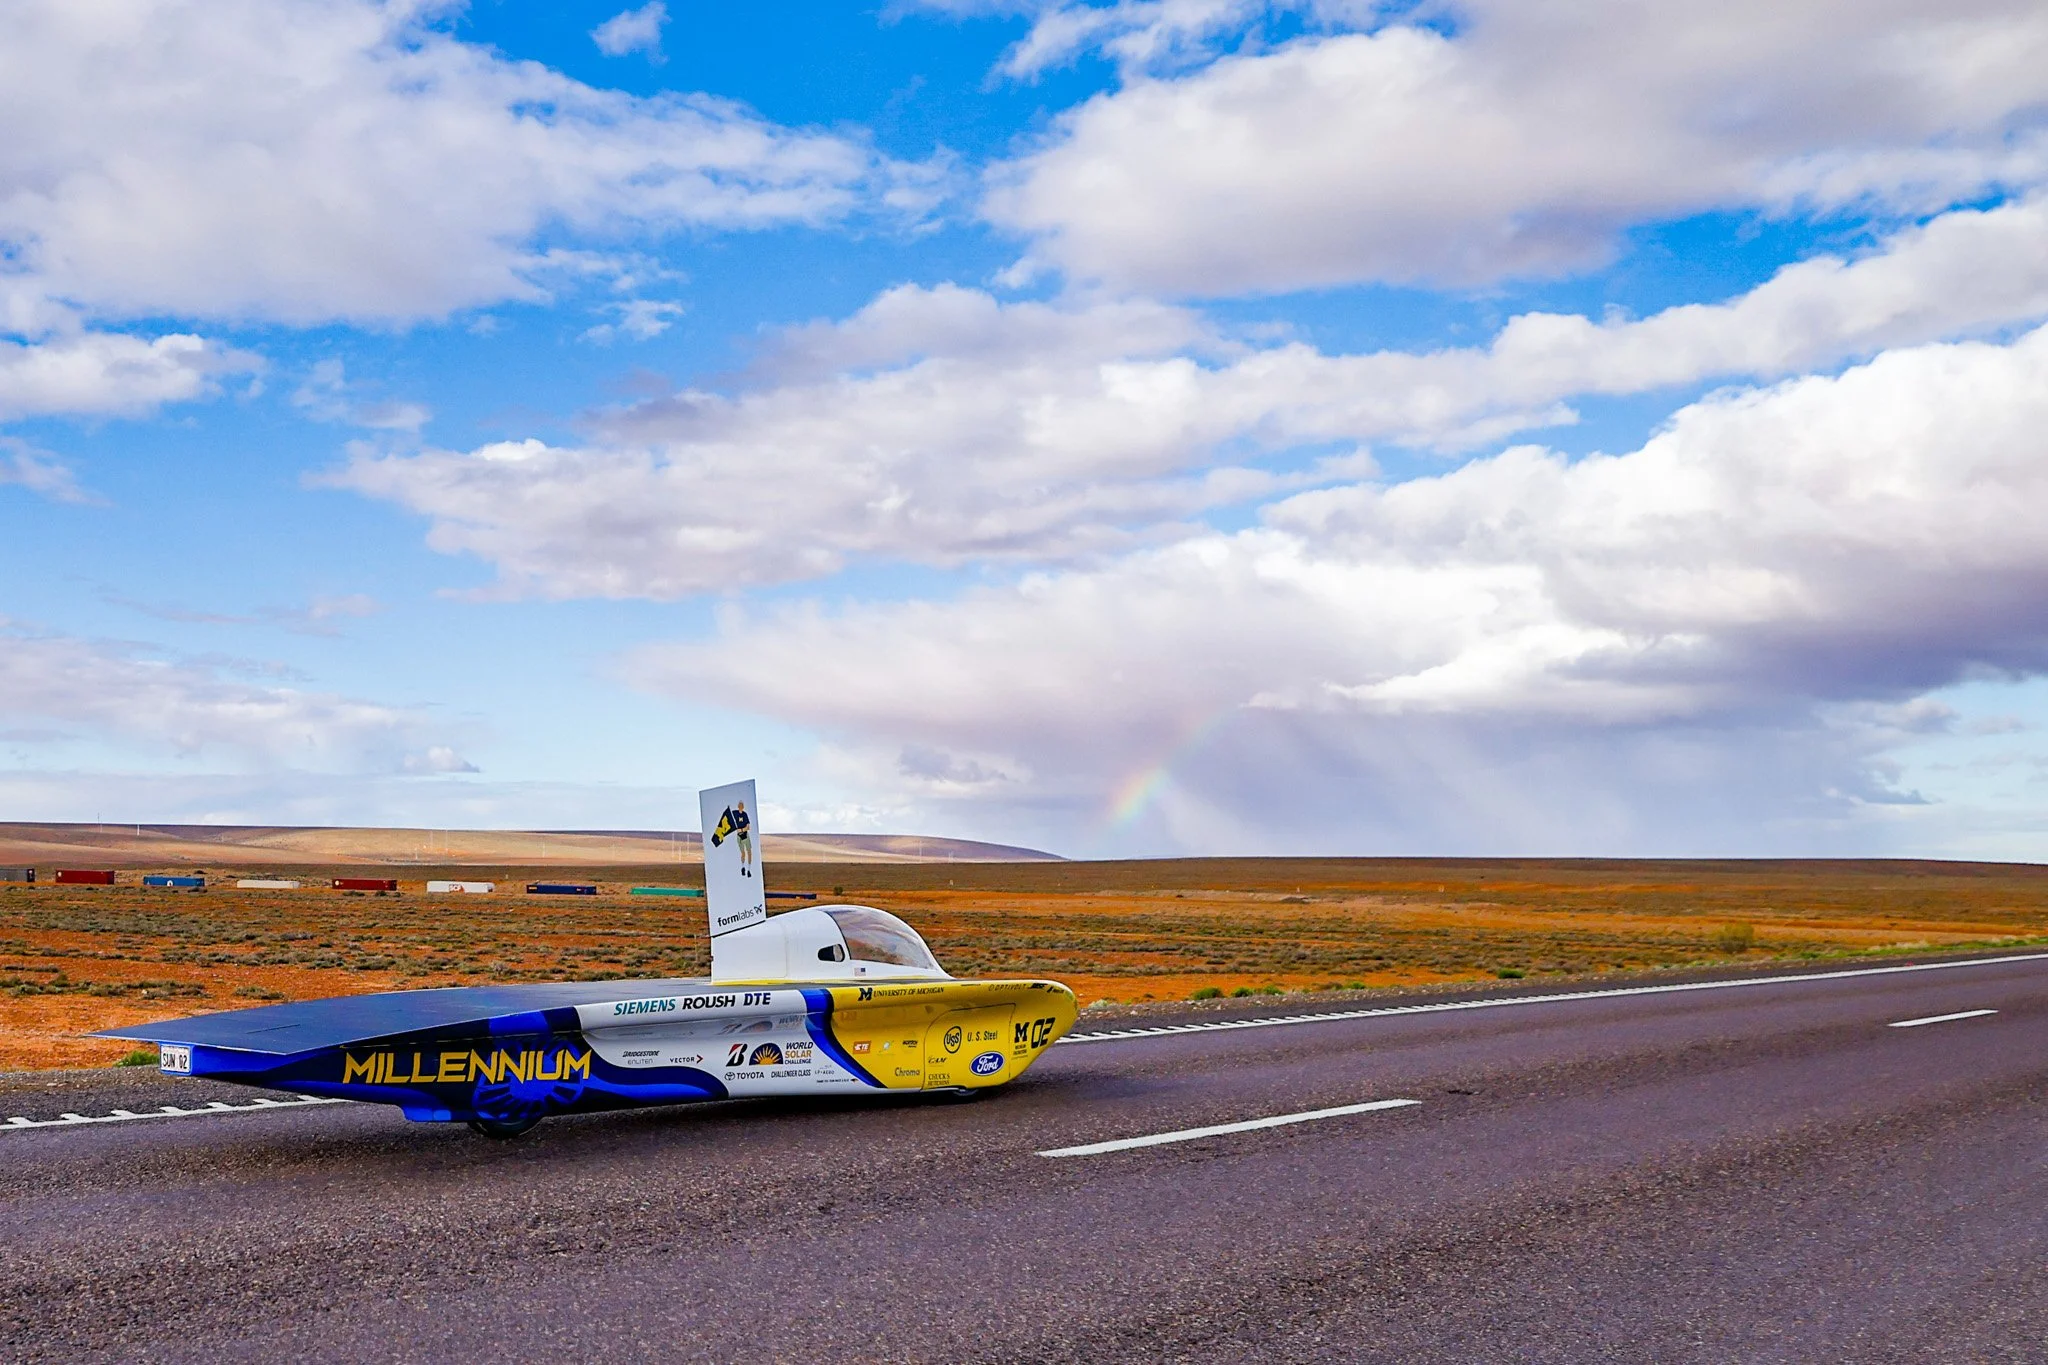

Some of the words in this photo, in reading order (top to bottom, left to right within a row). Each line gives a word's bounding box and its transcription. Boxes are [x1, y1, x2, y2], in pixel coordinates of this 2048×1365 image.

[717, 908, 755, 927] formlabs
[743, 992, 771, 1006] DTE
[857, 987, 873, 1001] M
[873, 989, 907, 997] UNIVERSITY
[917, 987, 945, 995] MICHIGAN
[613, 998, 676, 1016] SIEMENS
[682, 995, 736, 1010] ROUSH
[983, 1030, 998, 1041] Steel
[1014, 1021, 1030, 1043] M
[1031, 1017, 1056, 1049] 02
[786, 1041, 813, 1050] WORLD
[162, 1053, 176, 1068] SUN
[178, 1055, 188, 1069] 02
[622, 1050, 660, 1058] BRIDGESTONE
[669, 1056, 695, 1064] VECTOR
[785, 1050, 812, 1058] SOLAR
[342, 1047, 592, 1085] MILLENNIUM
[976, 1055, 999, 1073] Ford
[736, 1071, 765, 1080] TOYOTA
[770, 1069, 798, 1079] CHALLENGER
[797, 1069, 811, 1077] CLASS
[894, 1066, 920, 1077] Chroma
